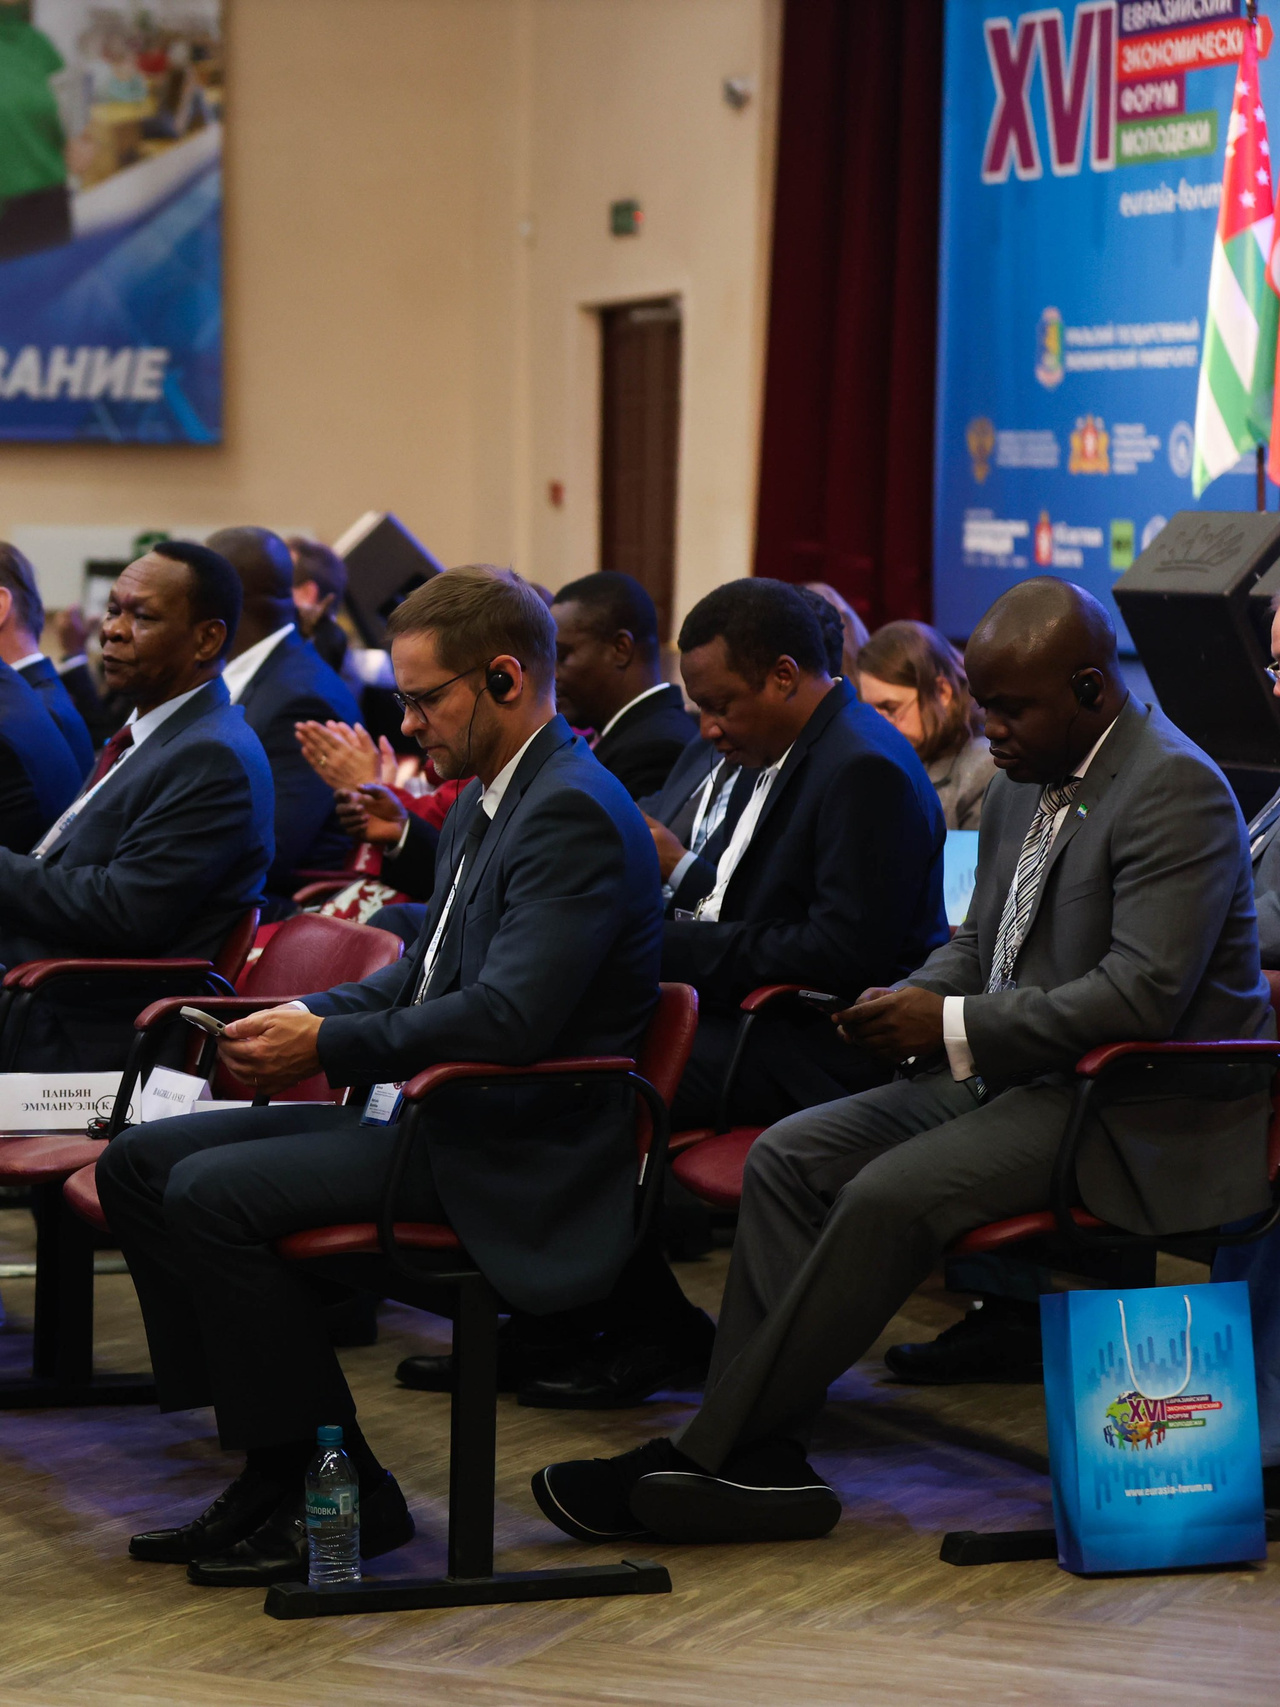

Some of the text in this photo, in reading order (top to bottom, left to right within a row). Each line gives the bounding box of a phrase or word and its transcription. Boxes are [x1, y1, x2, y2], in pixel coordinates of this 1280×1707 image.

[982, 0, 1116, 184] XVI
[1121, 79, 1179, 113] ФОРУМ
[42, 1088, 91, 1098] ПАНЬЯН
[22, 1101, 112, 1112] ЭММАНУЭЛЬ К.
[1127, 1398, 1167, 1424] XVI
[306, 1504, 337, 1516] ГОЛОВКА
